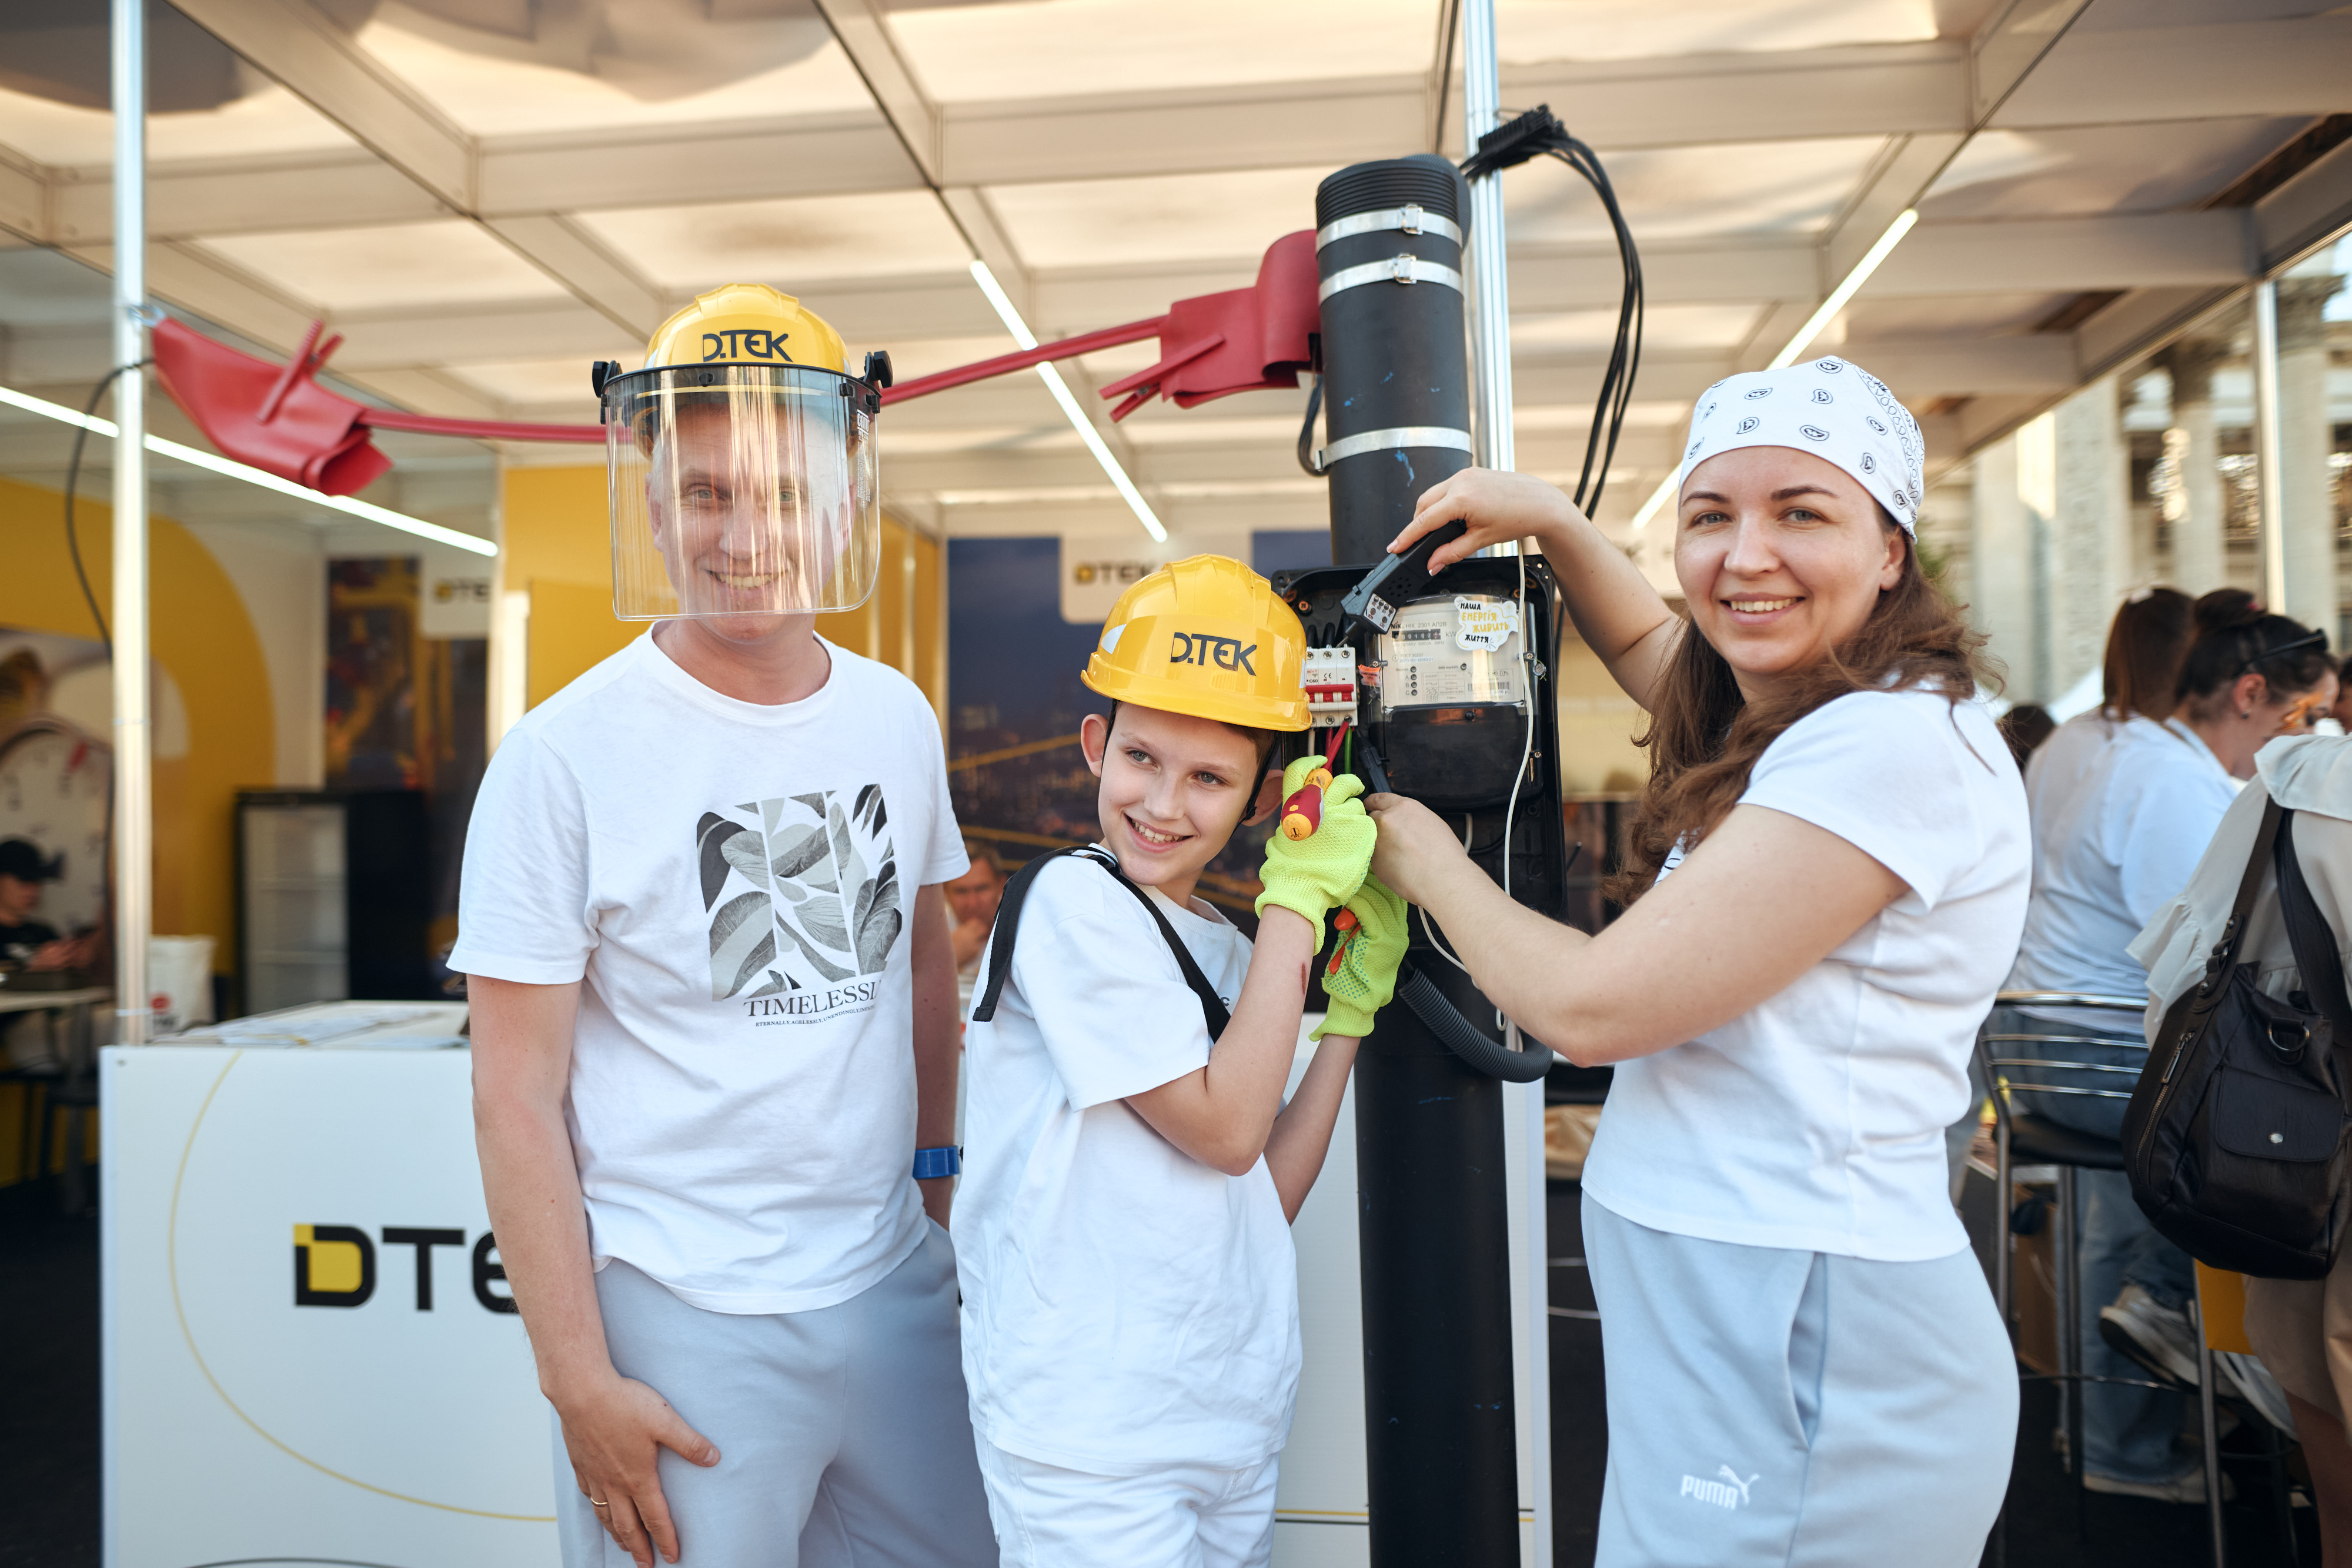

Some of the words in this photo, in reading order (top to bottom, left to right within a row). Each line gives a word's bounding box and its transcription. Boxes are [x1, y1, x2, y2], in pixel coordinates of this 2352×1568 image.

[1465, 634, 1489, 643] ЖИТТЯ
[1473, 621, 1509, 633] ЖИВИТЬ
[743, 980, 881, 1017] TIMELESSL
[293, 1223, 522, 1315] DTE
[1681, 1474, 1738, 1509] PUMA
